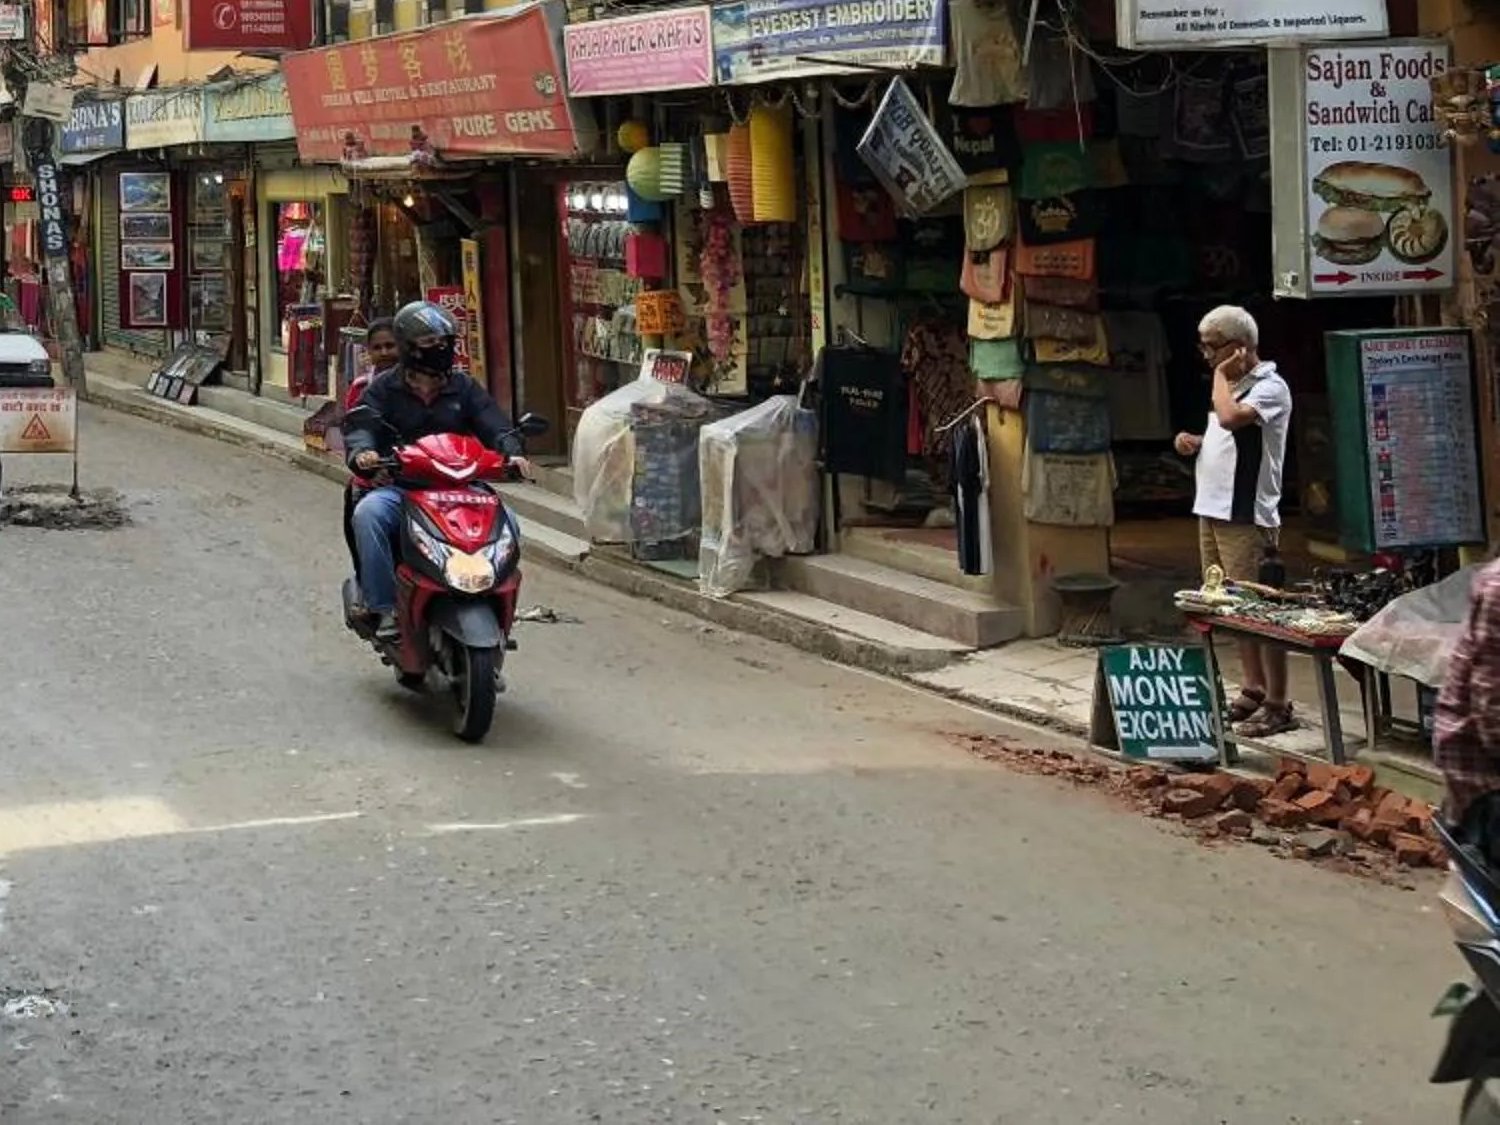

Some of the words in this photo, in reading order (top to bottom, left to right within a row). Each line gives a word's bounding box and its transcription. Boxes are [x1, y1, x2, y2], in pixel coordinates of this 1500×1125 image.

[751, 8, 822, 39] EVEREST
[1307, 52, 1372, 89] Sajan
[1379, 50, 1445, 79] Foods
[419, 73, 497, 98] RESTAURANT
[1370, 81, 1386, 97] &
[453, 113, 497, 138] PURE
[504, 108, 555, 133] GEMS
[1308, 100, 1400, 125] Sandwich
[953, 134, 995, 156] Nepal
[1310, 136, 1343, 152] Tel:
[38, 164, 63, 250] SHONAS
[1130, 648, 1185, 672] AJAY
[1115, 711, 1221, 740] EXCHAN
